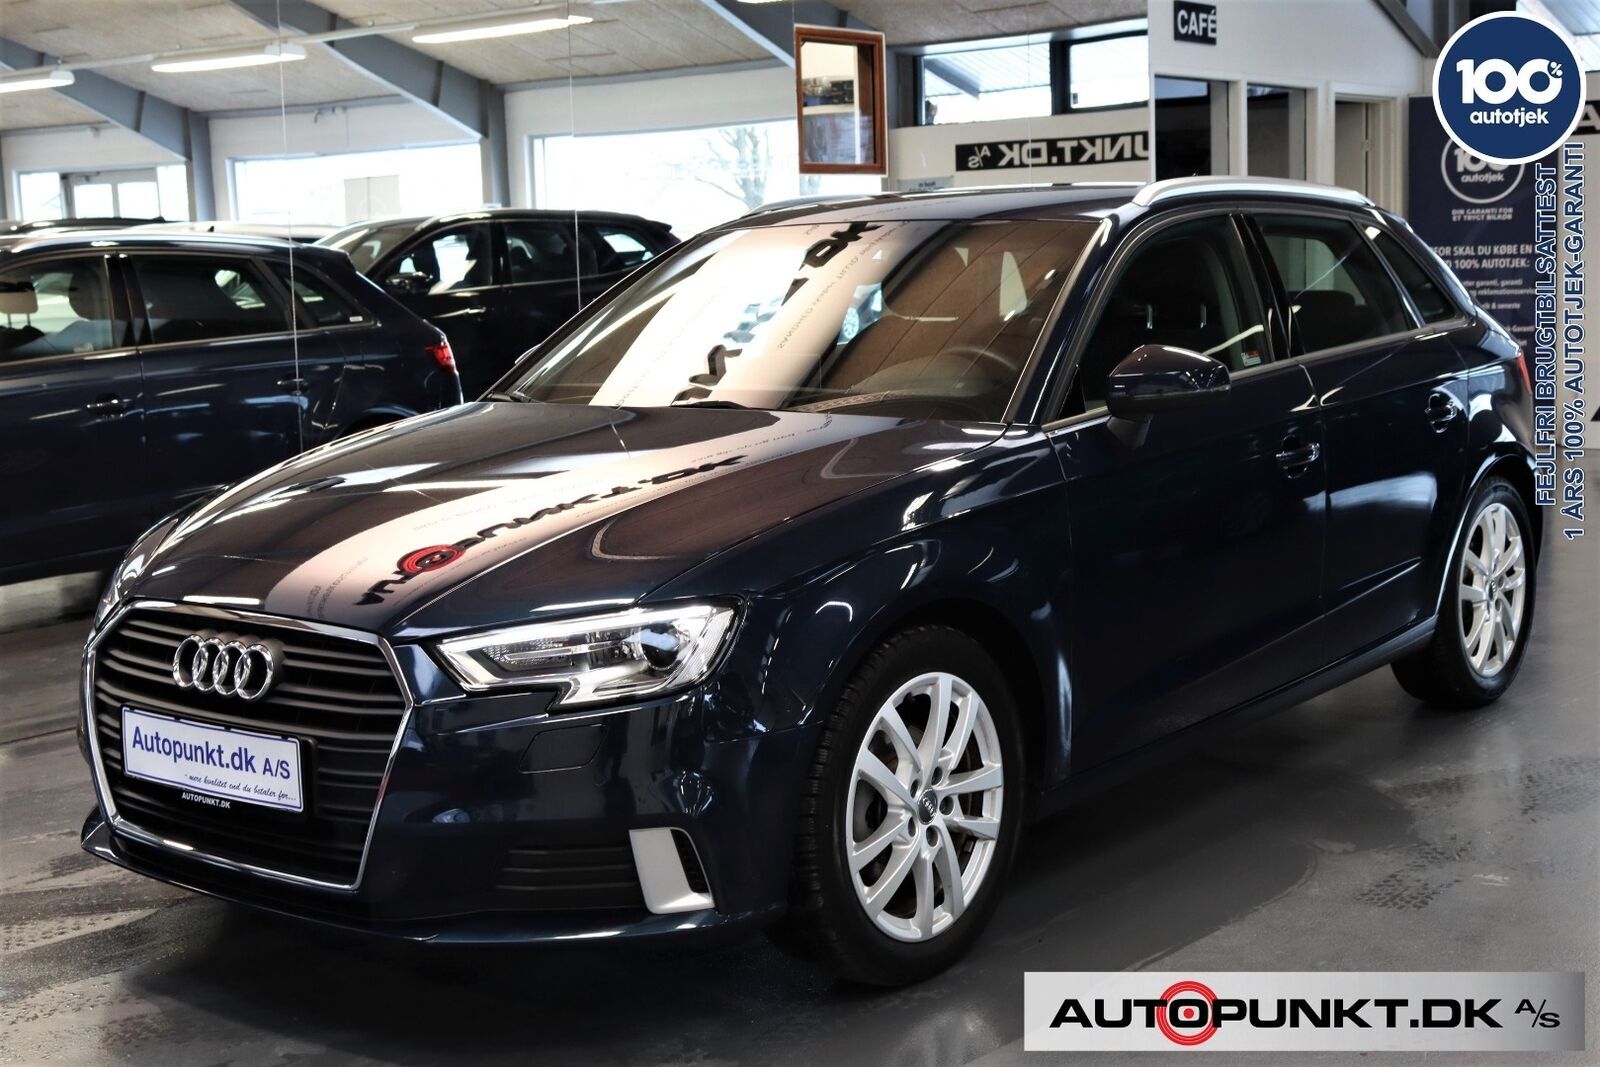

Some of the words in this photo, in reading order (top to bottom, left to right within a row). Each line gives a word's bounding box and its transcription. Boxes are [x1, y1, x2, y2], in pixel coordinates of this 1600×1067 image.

[1177, 9, 1216, 38] CAFÉ
[1454, 148, 1510, 172] 10
[1461, 172, 1504, 184] autotjek
[1453, 245, 1476, 256] SKAL
[1477, 245, 1491, 255] DU
[1493, 244, 1519, 255] KØBE
[1520, 243, 1533, 254] EN
[1455, 260, 1480, 270] 100%
[1481, 258, 1531, 269] AUTOTJEK:
[132, 726, 257, 773] Autopunkt.dk
[262, 757, 291, 780] A/S
[254, 785, 276, 798] betaler
[181, 792, 231, 809] AUTOPUNKT.DK
